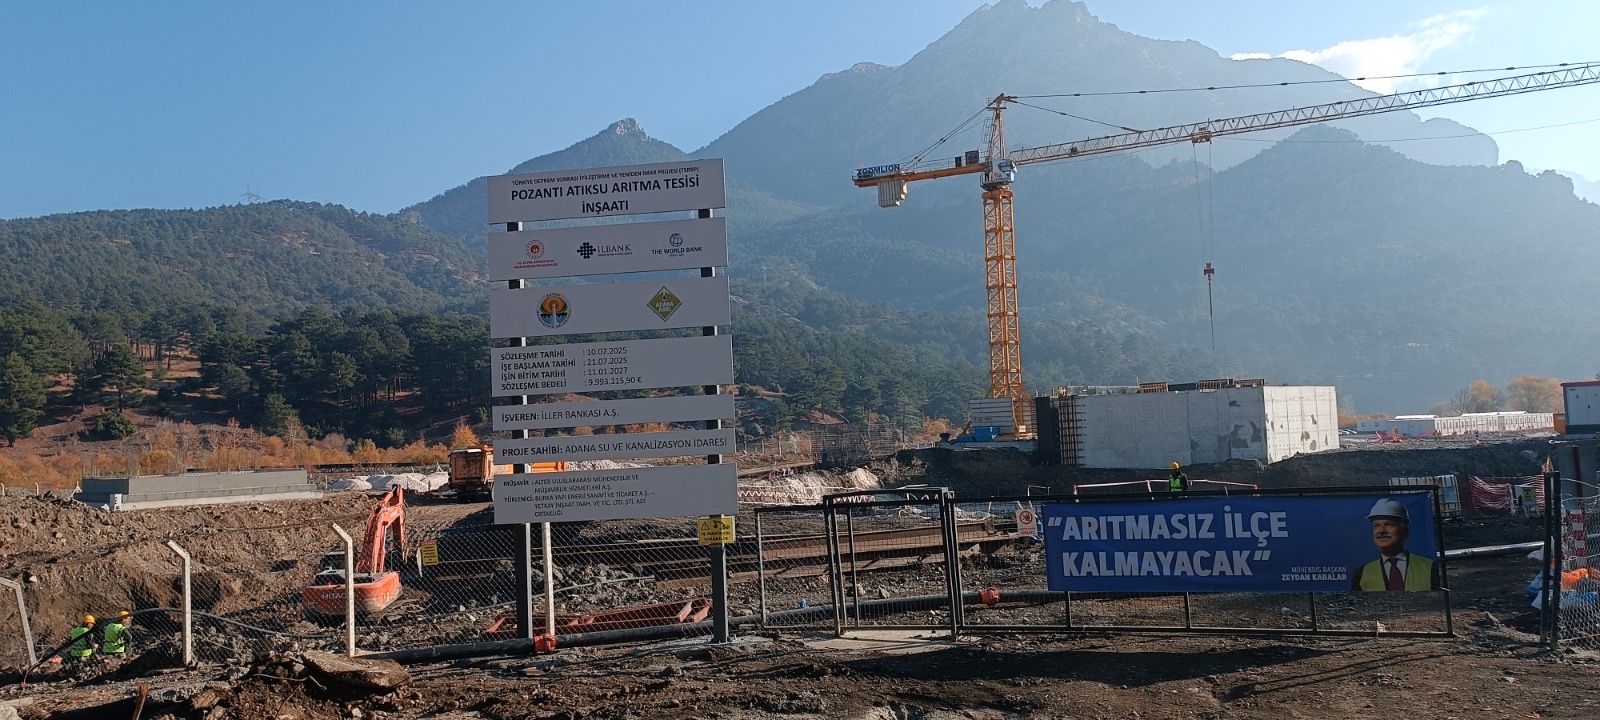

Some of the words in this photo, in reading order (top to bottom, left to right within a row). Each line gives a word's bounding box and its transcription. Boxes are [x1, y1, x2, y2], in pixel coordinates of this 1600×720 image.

[579, 173, 610, 181] İYİLEŞTİRME
[619, 170, 641, 178] YENİDEN
[657, 167, 678, 175] PROJESİ
[856, 164, 900, 177] ZOOMLION
[511, 186, 563, 201] POZANTI
[566, 183, 608, 197] ATIKSU
[611, 179, 661, 194] ARITMA
[663, 174, 699, 190] TESİSİ
[582, 200, 629, 214] İNŞAATI
[501, 351, 538, 361] SÖZLEŞME
[541, 349, 565, 358] TARİHİ
[587, 347, 627, 356] 10.07.2025
[501, 362, 512, 372] İŞE
[514, 360, 550, 370] BAŞLAMA
[552, 358, 576, 367] TARİHİ
[587, 357, 627, 366] 21.07.2025
[501, 373, 516, 382] İŞİN
[518, 370, 539, 380] BİTİM
[541, 368, 566, 378] TARİHİ
[588, 367, 628, 376] 11.01.2027
[502, 381, 539, 391] SÖZLEŞME
[542, 379, 567, 388] BEDELİ
[588, 376, 636, 386] 9.993.115,90
[501, 412, 539, 423] İŞVEREN:
[541, 410, 563, 420] İLLER
[565, 409, 601, 419] BANKASI
[603, 408, 619, 418] A.Ş.
[502, 447, 529, 456] PROJE
[531, 444, 563, 455] SAHİBİ:
[565, 444, 596, 454] ADANA
[598, 443, 610, 452] SU
[612, 442, 623, 451] VE
[625, 439, 691, 450] KANALİZASYON
[693, 437, 727, 447] İDARESİ
[504, 479, 529, 487] MÜŞAVİR
[552, 477, 592, 485] ULUSLARARASI
[534, 485, 567, 494] MÜŞAVİRLİK
[568, 483, 601, 492] HİZMETLERİ
[504, 494, 534, 503] YÜKLENİCİ:
[586, 491, 606, 499] SANAYİ
[556, 501, 574, 509] İNŞAAT
[1223, 505, 1289, 547] İLÇE
[1291, 565, 1321, 573] MÜHENDİS
[1322, 566, 1346, 574] BAŞKAN
[1281, 573, 1310, 581] ZEYDAN
[1312, 573, 1347, 581] KARALAR
